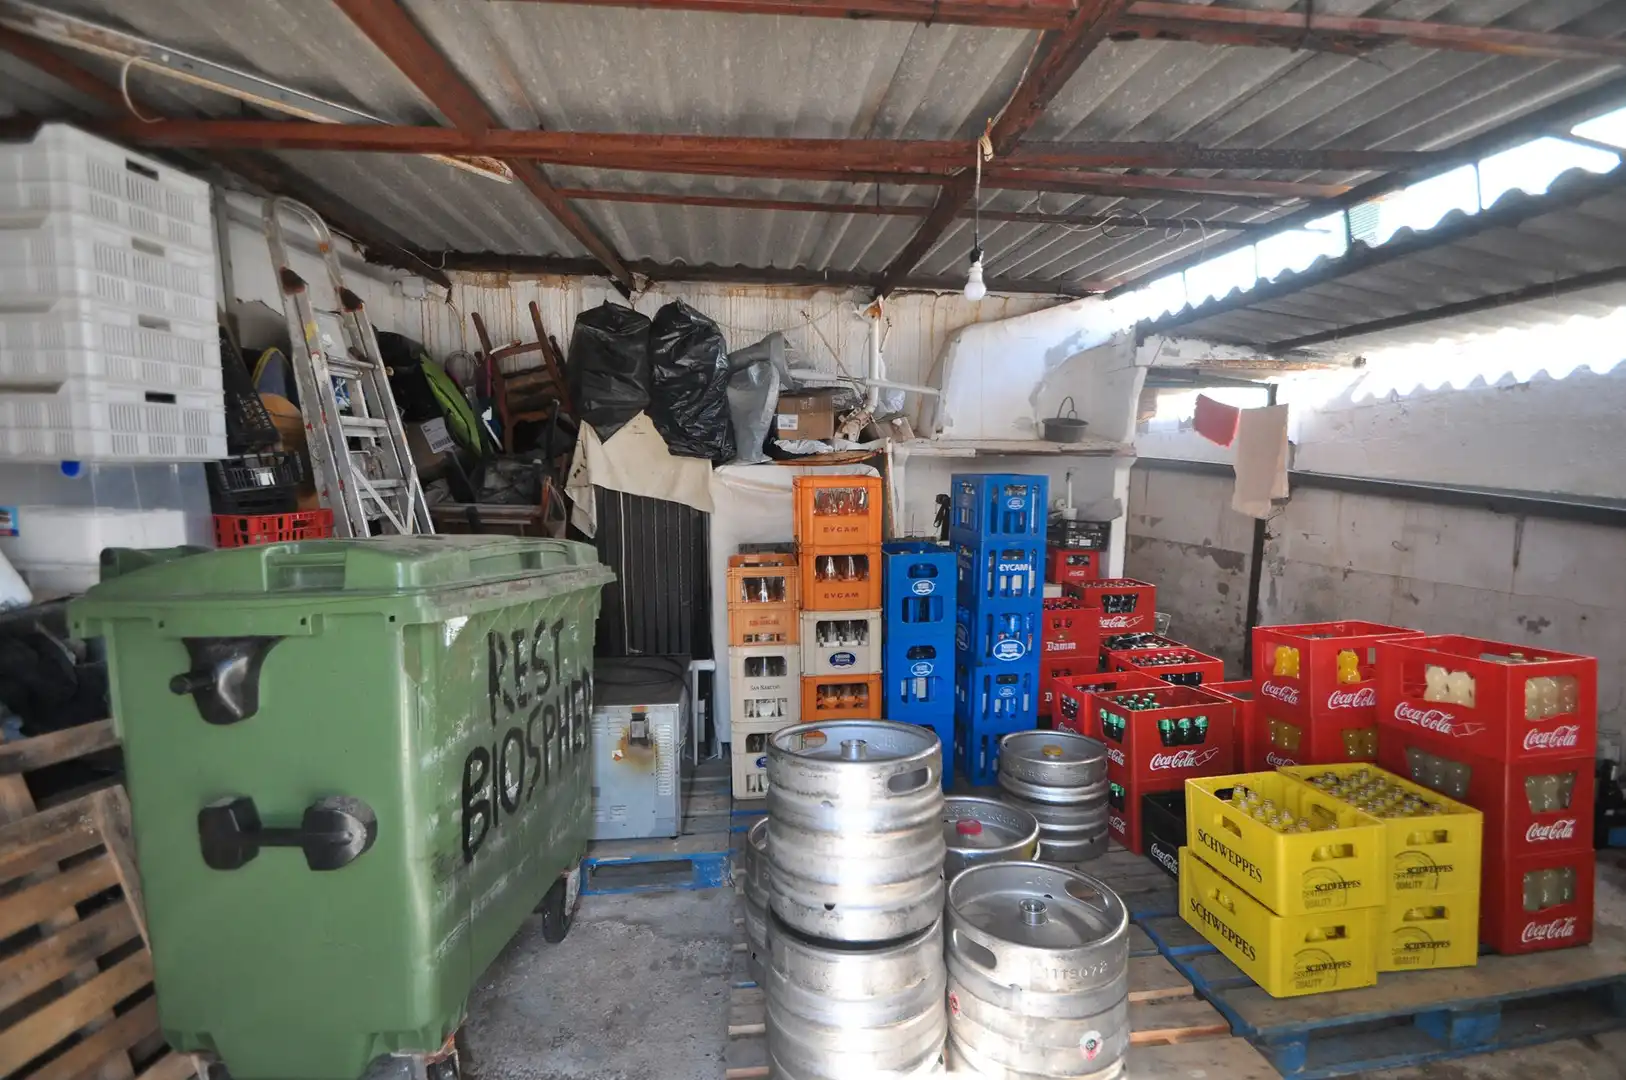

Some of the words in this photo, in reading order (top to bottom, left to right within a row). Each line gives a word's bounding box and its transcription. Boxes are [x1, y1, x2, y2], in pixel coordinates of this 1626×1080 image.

[999, 563, 1029, 572] EYCAM
[1046, 641, 1076, 651] Damm
[488, 617, 564, 726] REST
[1261, 681, 1299, 705] Coca-Cola
[1394, 702, 1456, 734] Coca-Cola
[1523, 725, 1580, 750] Coca-Cola
[1150, 750, 1197, 771] Coca-Cola
[1525, 819, 1576, 842] Coca-Cola
[1150, 842, 1179, 874] Coca-Cola
[1197, 828, 1263, 884] SCHWEPPES
[1406, 865, 1453, 874] SCHWEPPES
[1314, 880, 1361, 892] SCHWEPPES
[1189, 897, 1257, 962] SCHWEPPES
[1521, 917, 1577, 943] Coca-Cola
[1404, 941, 1450, 950] SCHWEPPES
[1305, 961, 1352, 972] SCHWEPPES
